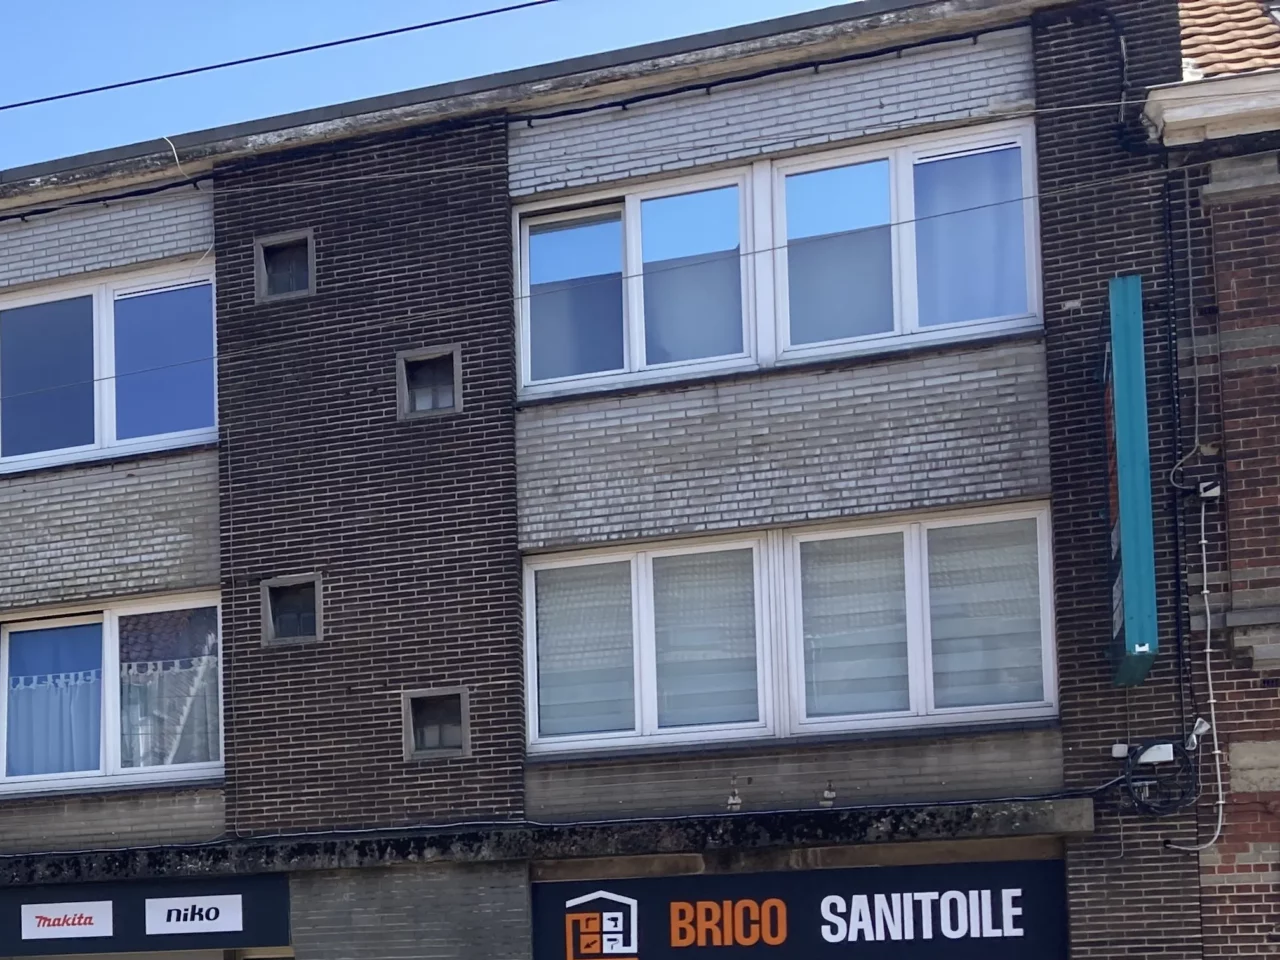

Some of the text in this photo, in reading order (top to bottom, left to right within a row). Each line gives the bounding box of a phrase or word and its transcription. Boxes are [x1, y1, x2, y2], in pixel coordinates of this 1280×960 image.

[166, 904, 220, 922] niko
[669, 887, 1024, 948] BRICO SANITOILE
